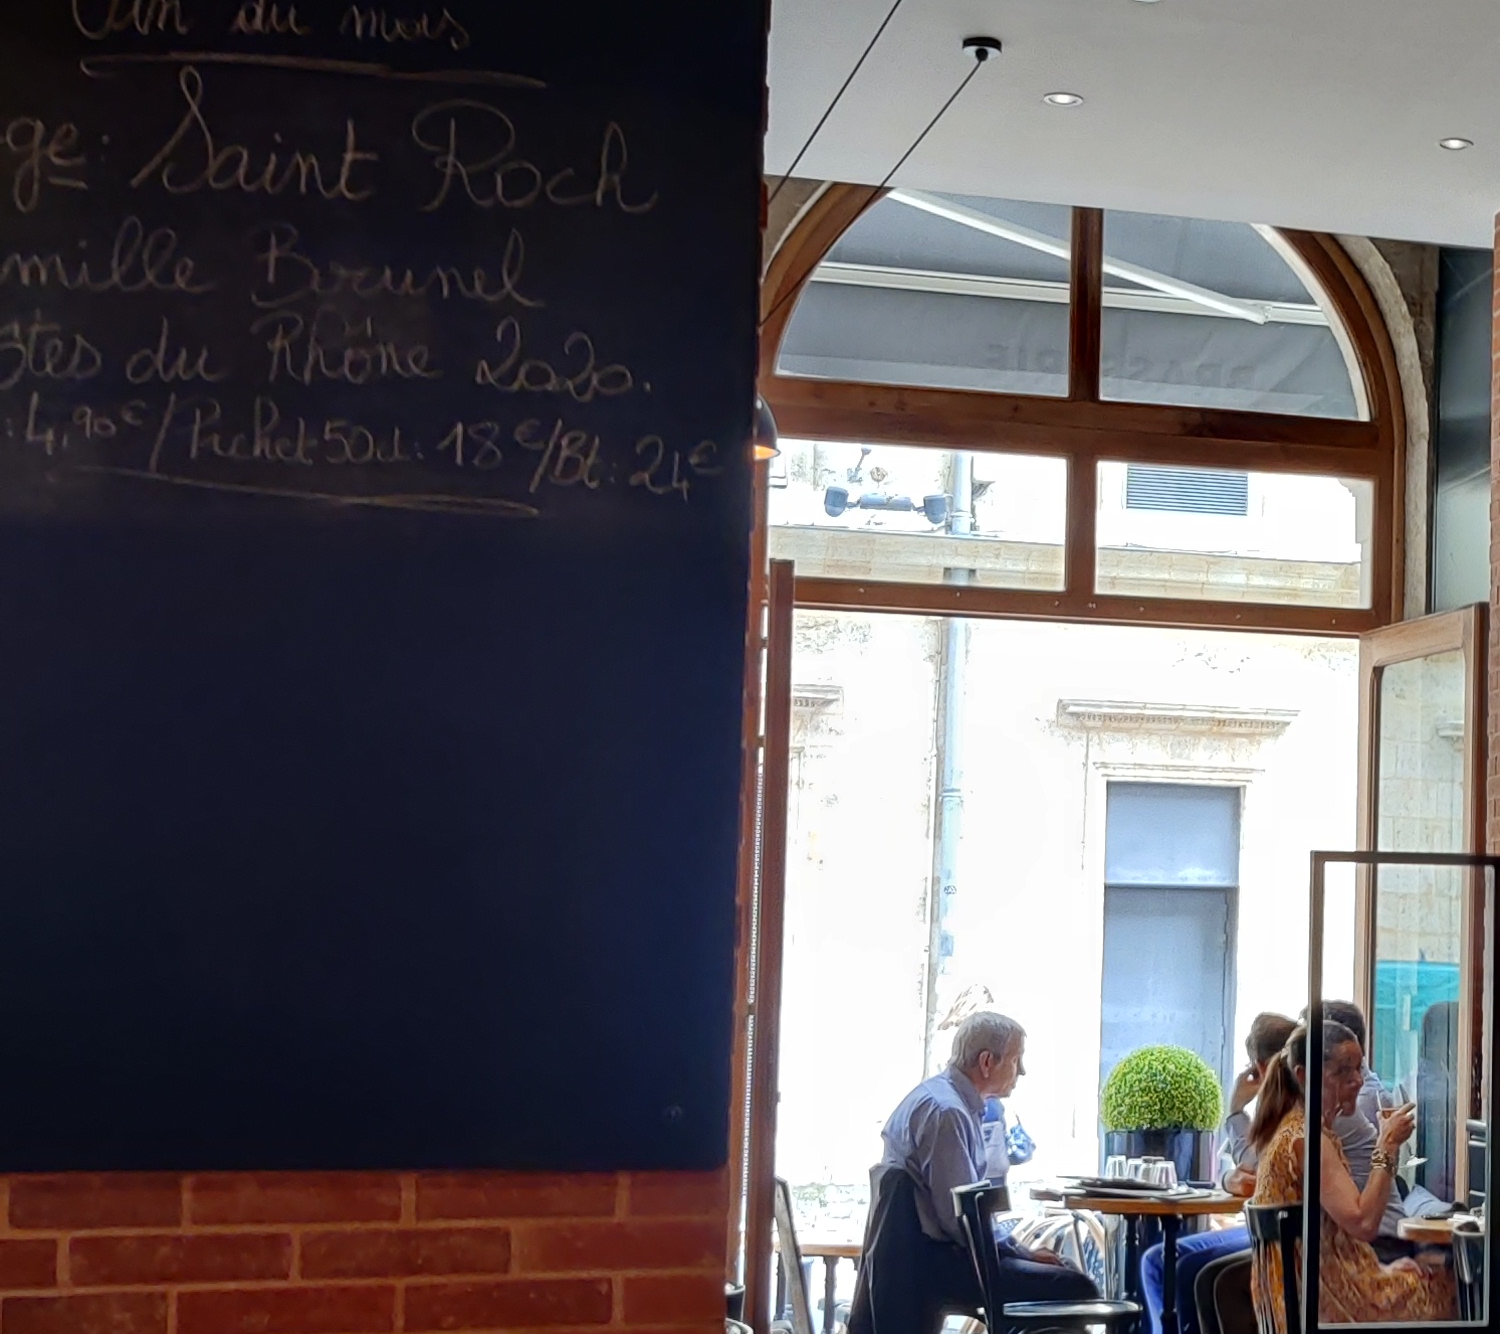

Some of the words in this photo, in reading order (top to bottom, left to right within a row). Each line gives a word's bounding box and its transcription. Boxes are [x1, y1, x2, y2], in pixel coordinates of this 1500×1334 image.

[130, 65, 380, 202] Saint
[411, 98, 659, 214] Roch
[250, 221, 546, 308] Brunel
[125, 314, 233, 386] du
[250, 305, 445, 387] Rhône
